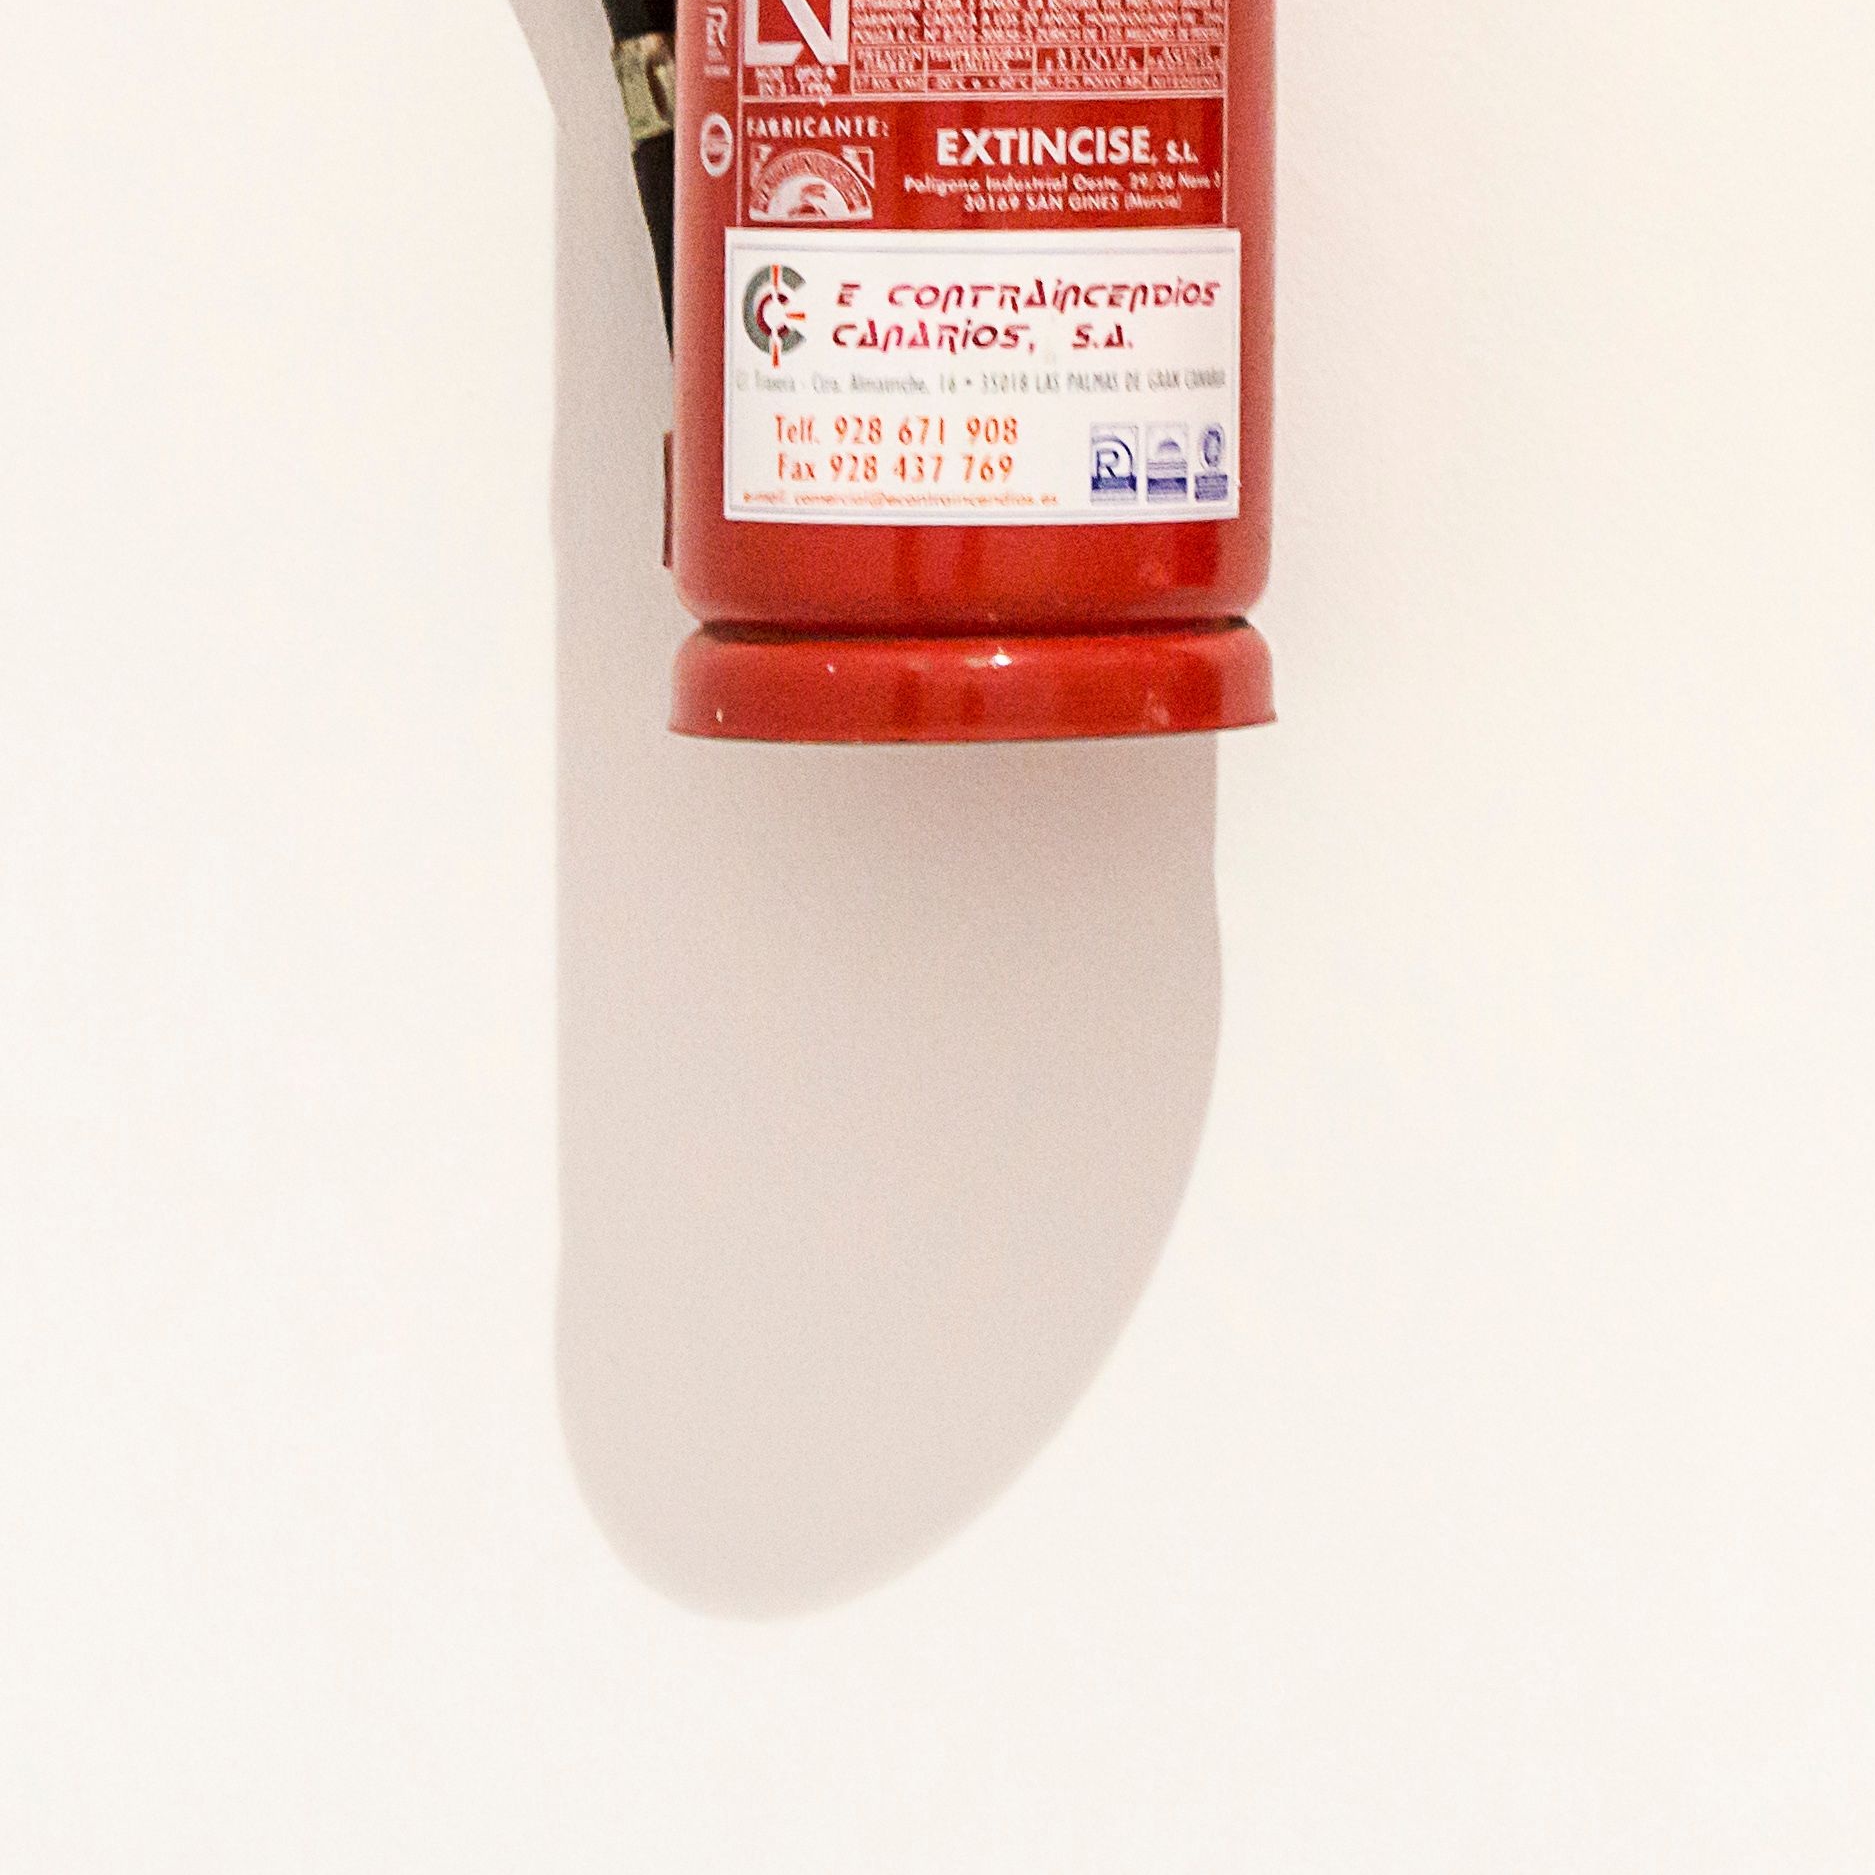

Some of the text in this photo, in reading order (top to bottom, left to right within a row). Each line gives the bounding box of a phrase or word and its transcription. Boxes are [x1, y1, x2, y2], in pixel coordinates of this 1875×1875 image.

[746, 114, 890, 140] FABRICANTE:
[836, 282, 861, 310] E
[775, 414, 1020, 447] Telf. 928 671 908
[776, 452, 1015, 484] Fax 928 437 769
